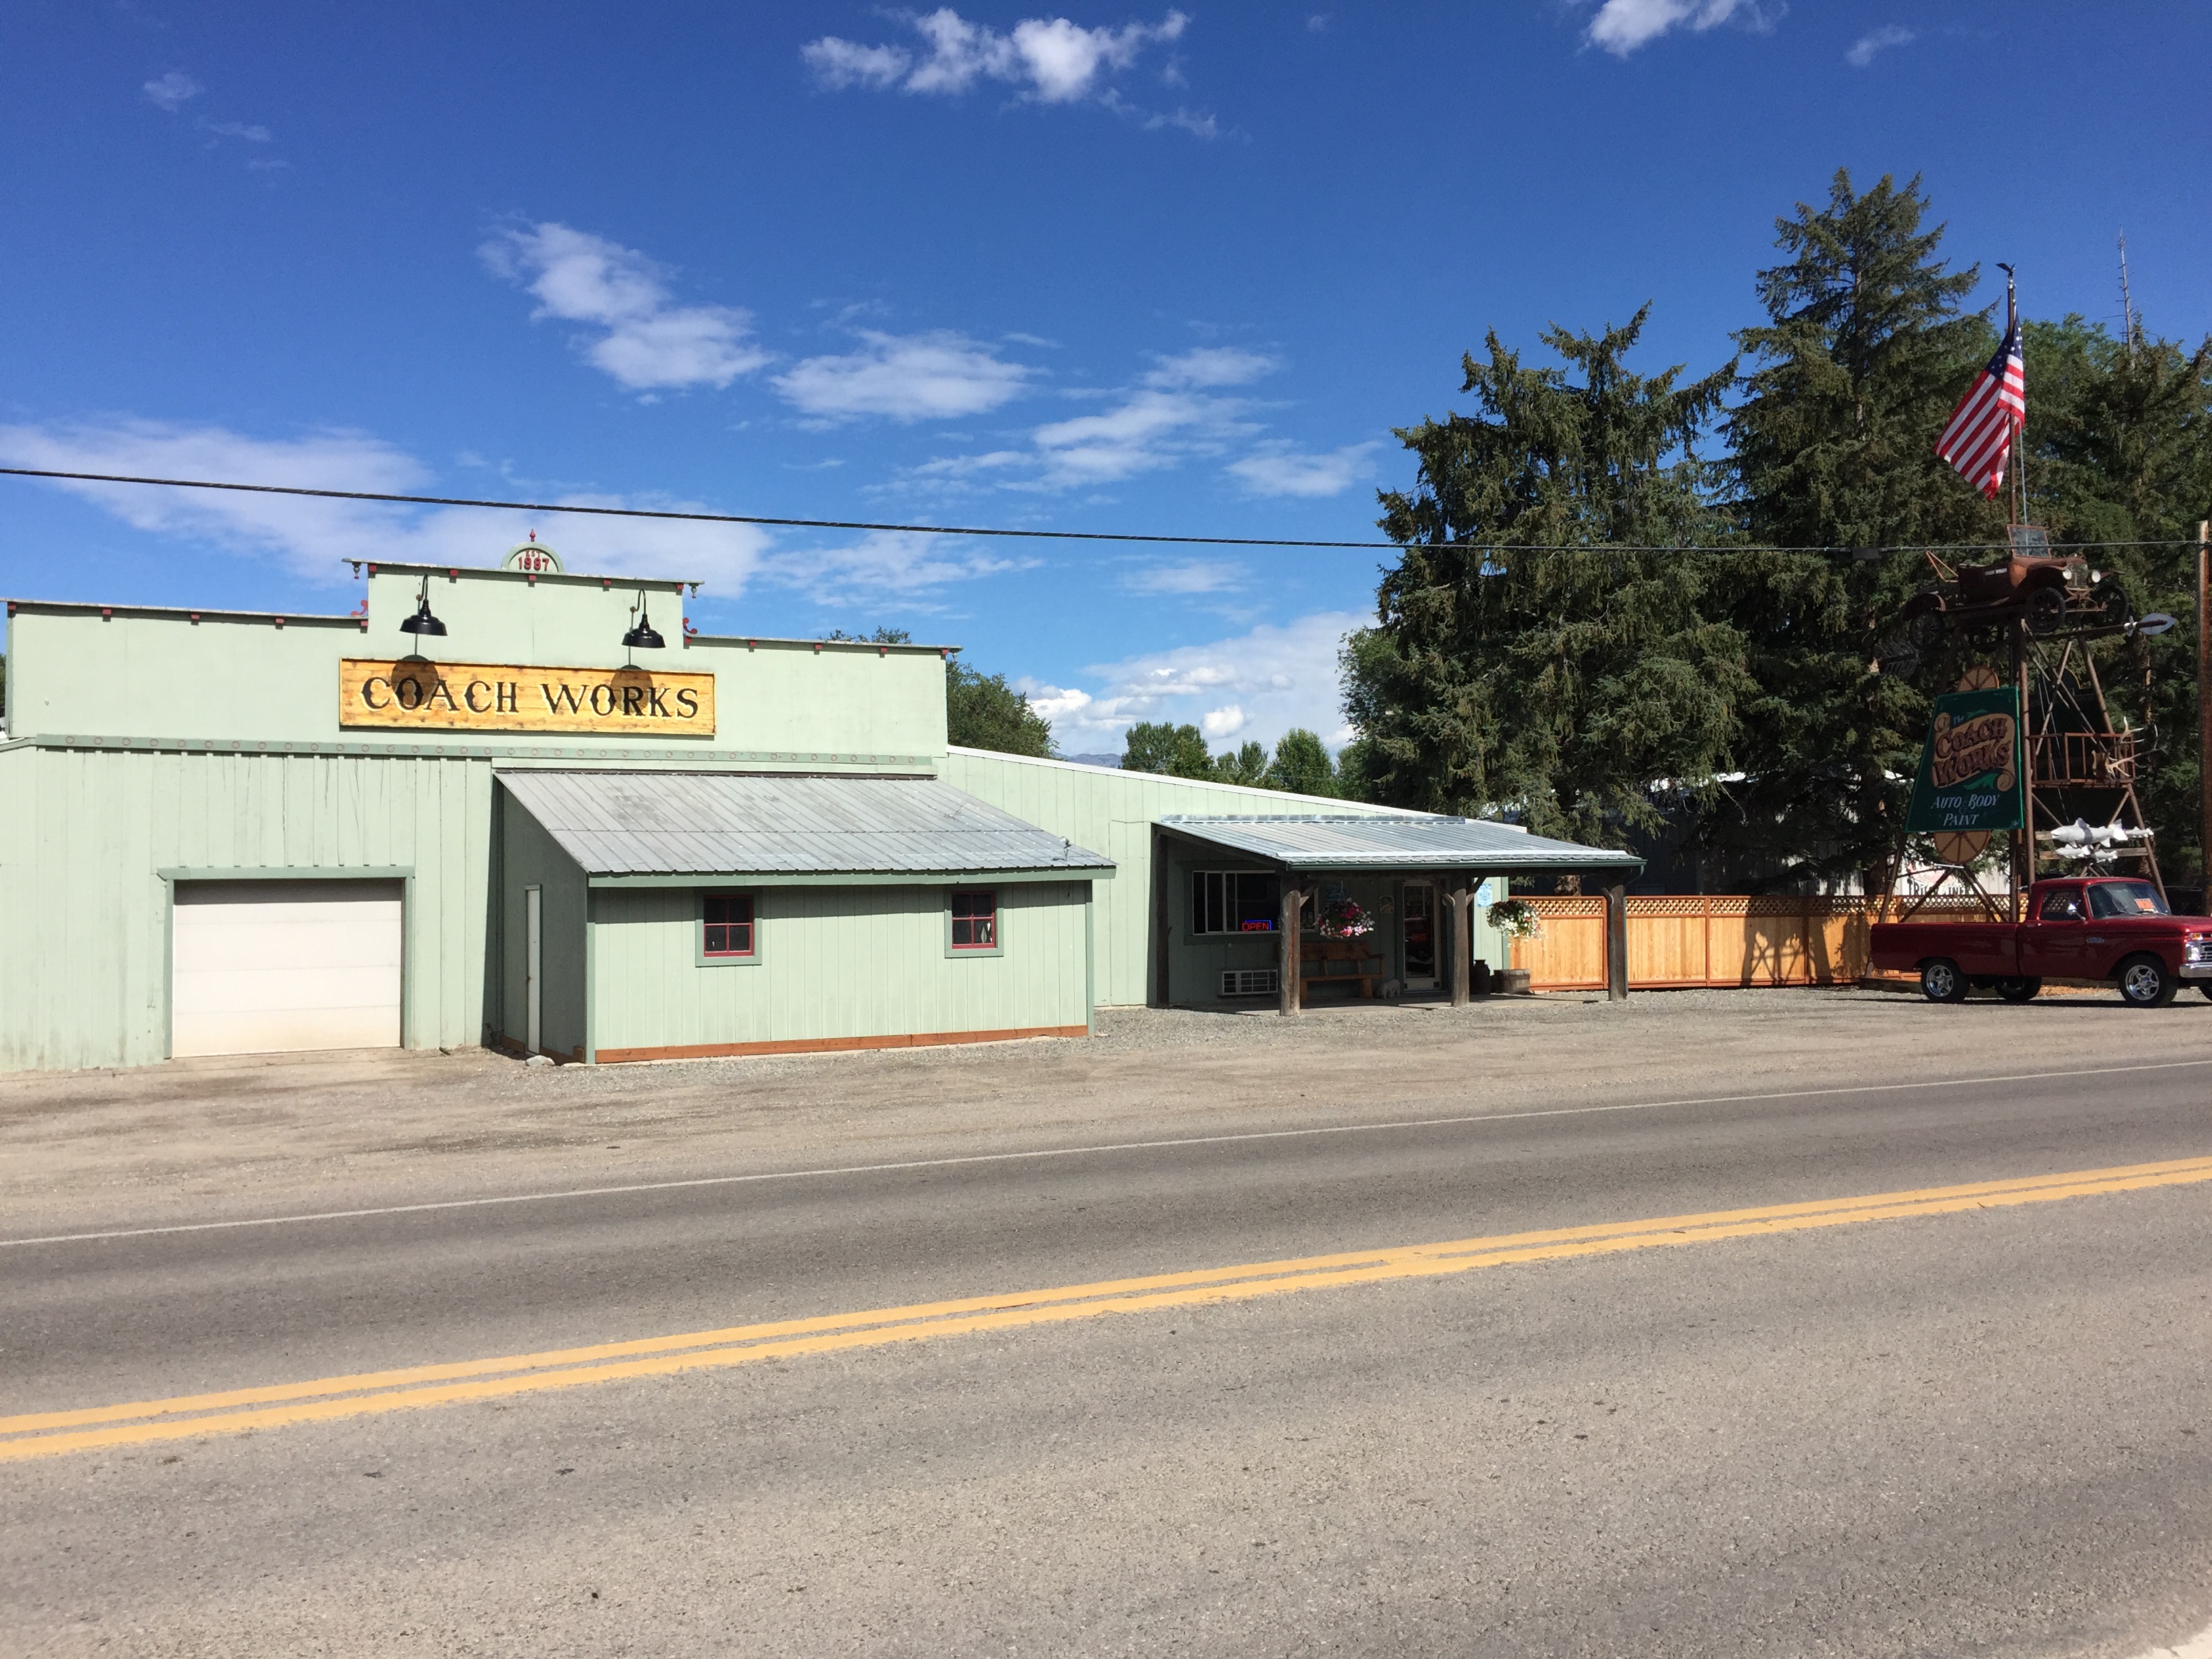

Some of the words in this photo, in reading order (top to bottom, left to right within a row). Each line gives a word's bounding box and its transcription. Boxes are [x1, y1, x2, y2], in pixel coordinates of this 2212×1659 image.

[525, 550, 541, 558] EST
[518, 556, 550, 571] 1987
[359, 676, 519, 713] COACH
[541, 682, 699, 719] WORKS
[1936, 718, 2008, 758] COACH
[1933, 737, 2011, 785] WORKS
[1931, 796, 1963, 809] AUTO
[1967, 794, 2000, 809] BODY
[1942, 813, 1980, 826] PAINT
[1242, 922, 1269, 931] OPEN
